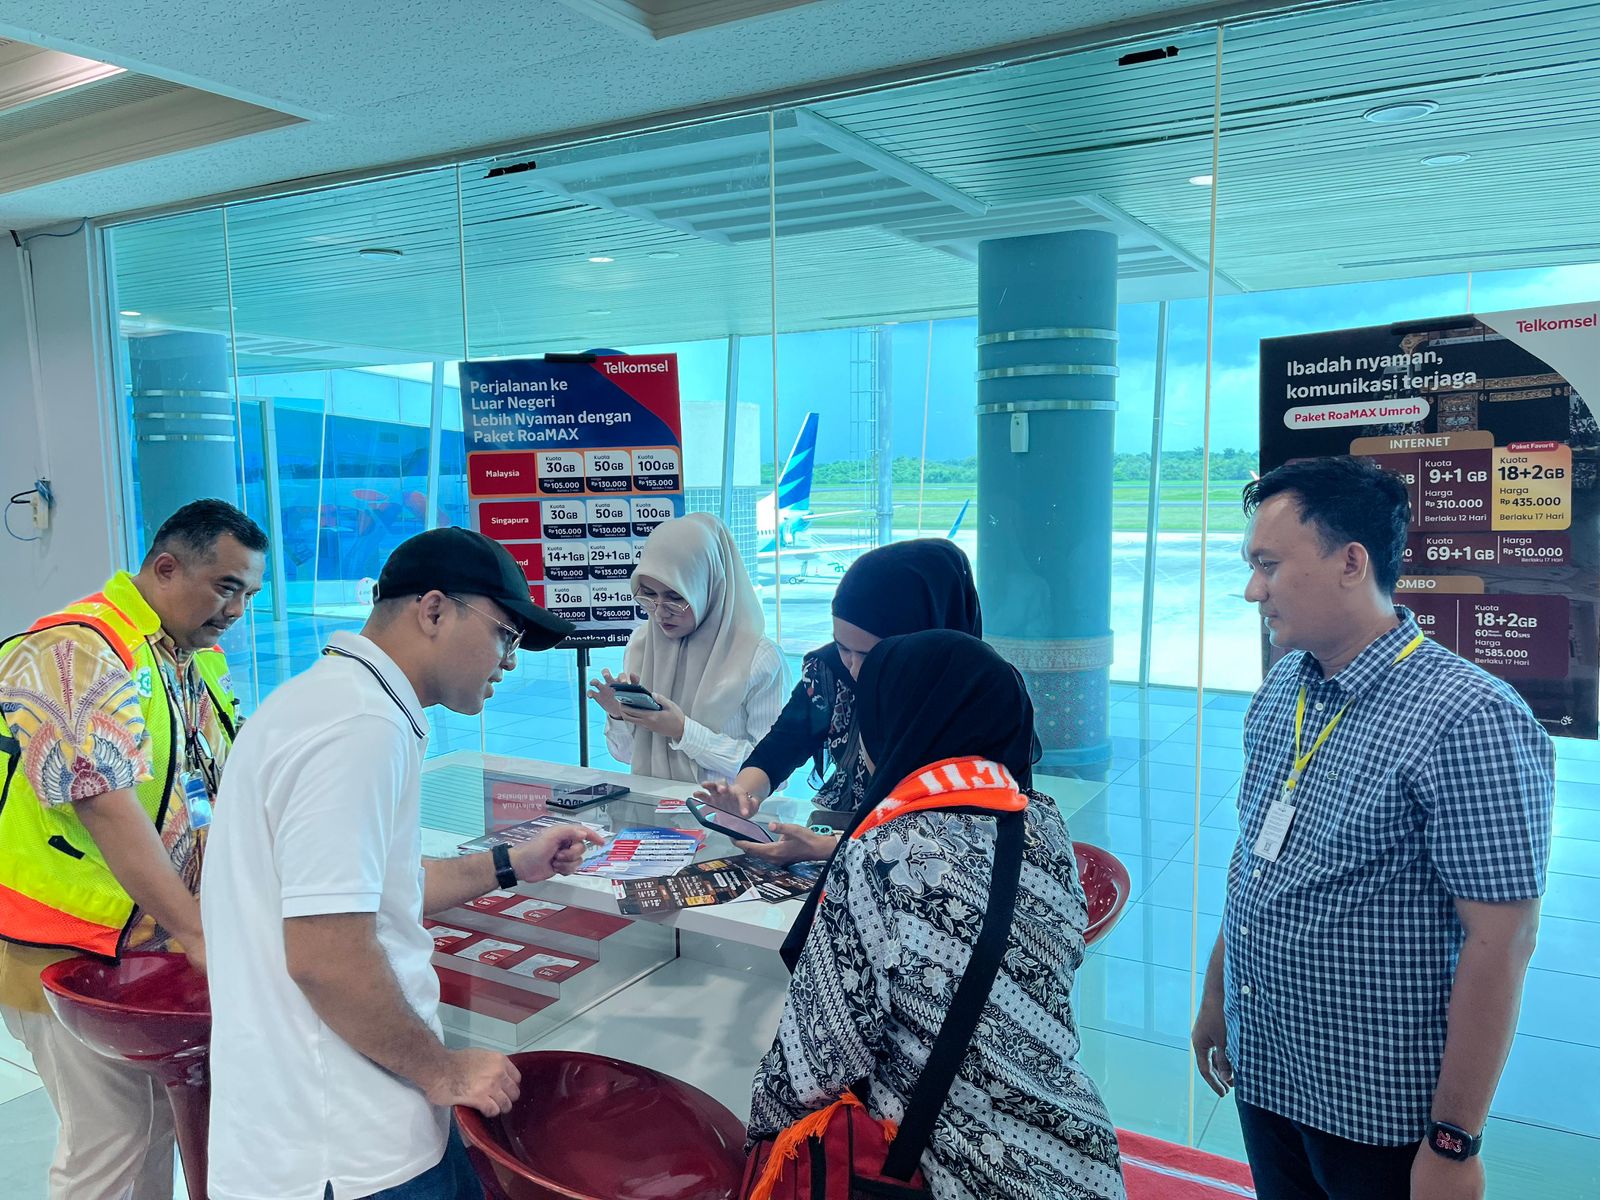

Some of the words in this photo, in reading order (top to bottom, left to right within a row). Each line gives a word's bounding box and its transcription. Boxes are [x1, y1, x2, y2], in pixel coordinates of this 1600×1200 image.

[1516, 314, 1598, 333] Telkomsel
[603, 360, 668, 374] Telkomsel
[1286, 356, 1351, 376] Ibadah
[1356, 350, 1443, 373] nyaman,
[470, 379, 548, 395] Perjalanan
[550, 378, 568, 391] ke
[1286, 376, 1398, 400] komunikasi
[1403, 371, 1477, 392] terjaga
[471, 397, 504, 410] Luar
[507, 395, 556, 412] Negeri
[472, 413, 512, 426] Lebih
[514, 413, 575, 428] Nyaman
[578, 410, 632, 426] dengan
[1294, 412, 1326, 423] Paket
[1328, 408, 1377, 420] RoaMAX
[1379, 405, 1420, 416] Umroh
[474, 430, 514, 443] Paket
[518, 428, 580, 442] RoaMAX
[1389, 436, 1450, 450] INTERNET
[546, 462, 576, 473] 30GB
[594, 461, 624, 472] 50GB
[638, 460, 674, 472] 100GB
[486, 469, 520, 478] Malaysia
[1425, 490, 1453, 498] Harga
[1500, 488, 1528, 496] Harga
[551, 510, 578, 520] 30GB
[596, 508, 624, 519] 50GB
[636, 508, 671, 518] 100GB
[491, 516, 529, 526] Singapura
[1503, 537, 1532, 546] Harga
[1396, 580, 1436, 589] OMBO
[555, 594, 582, 603] 30GB
